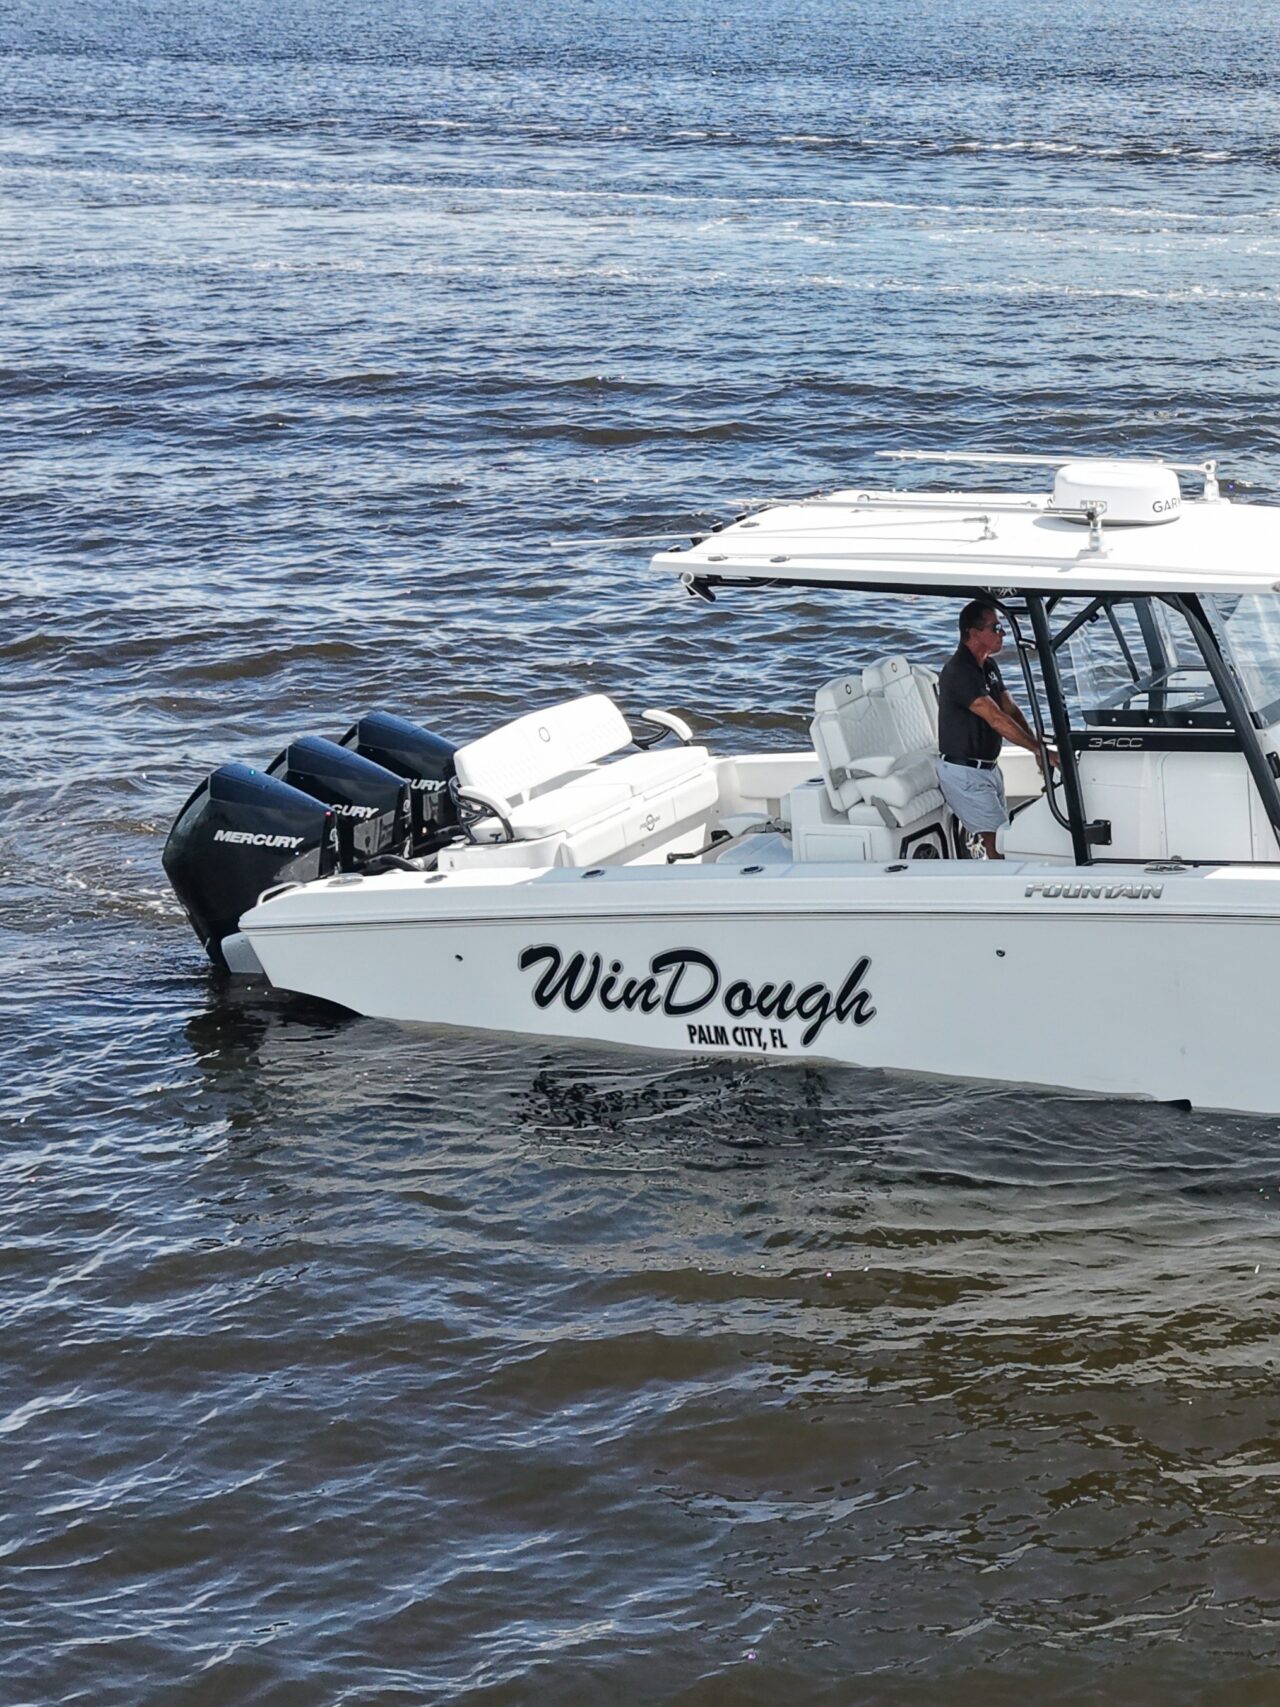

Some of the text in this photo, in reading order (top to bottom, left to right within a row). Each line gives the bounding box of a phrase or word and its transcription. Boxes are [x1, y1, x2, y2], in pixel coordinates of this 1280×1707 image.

[1088, 737, 1143, 748] 34CC
[213, 829, 305, 849] MERCURY
[1024, 882, 1165, 900] FOUNTAIN
[517, 943, 877, 1048] WinDough
[686, 1023, 788, 1051] PALM CITY, FL
